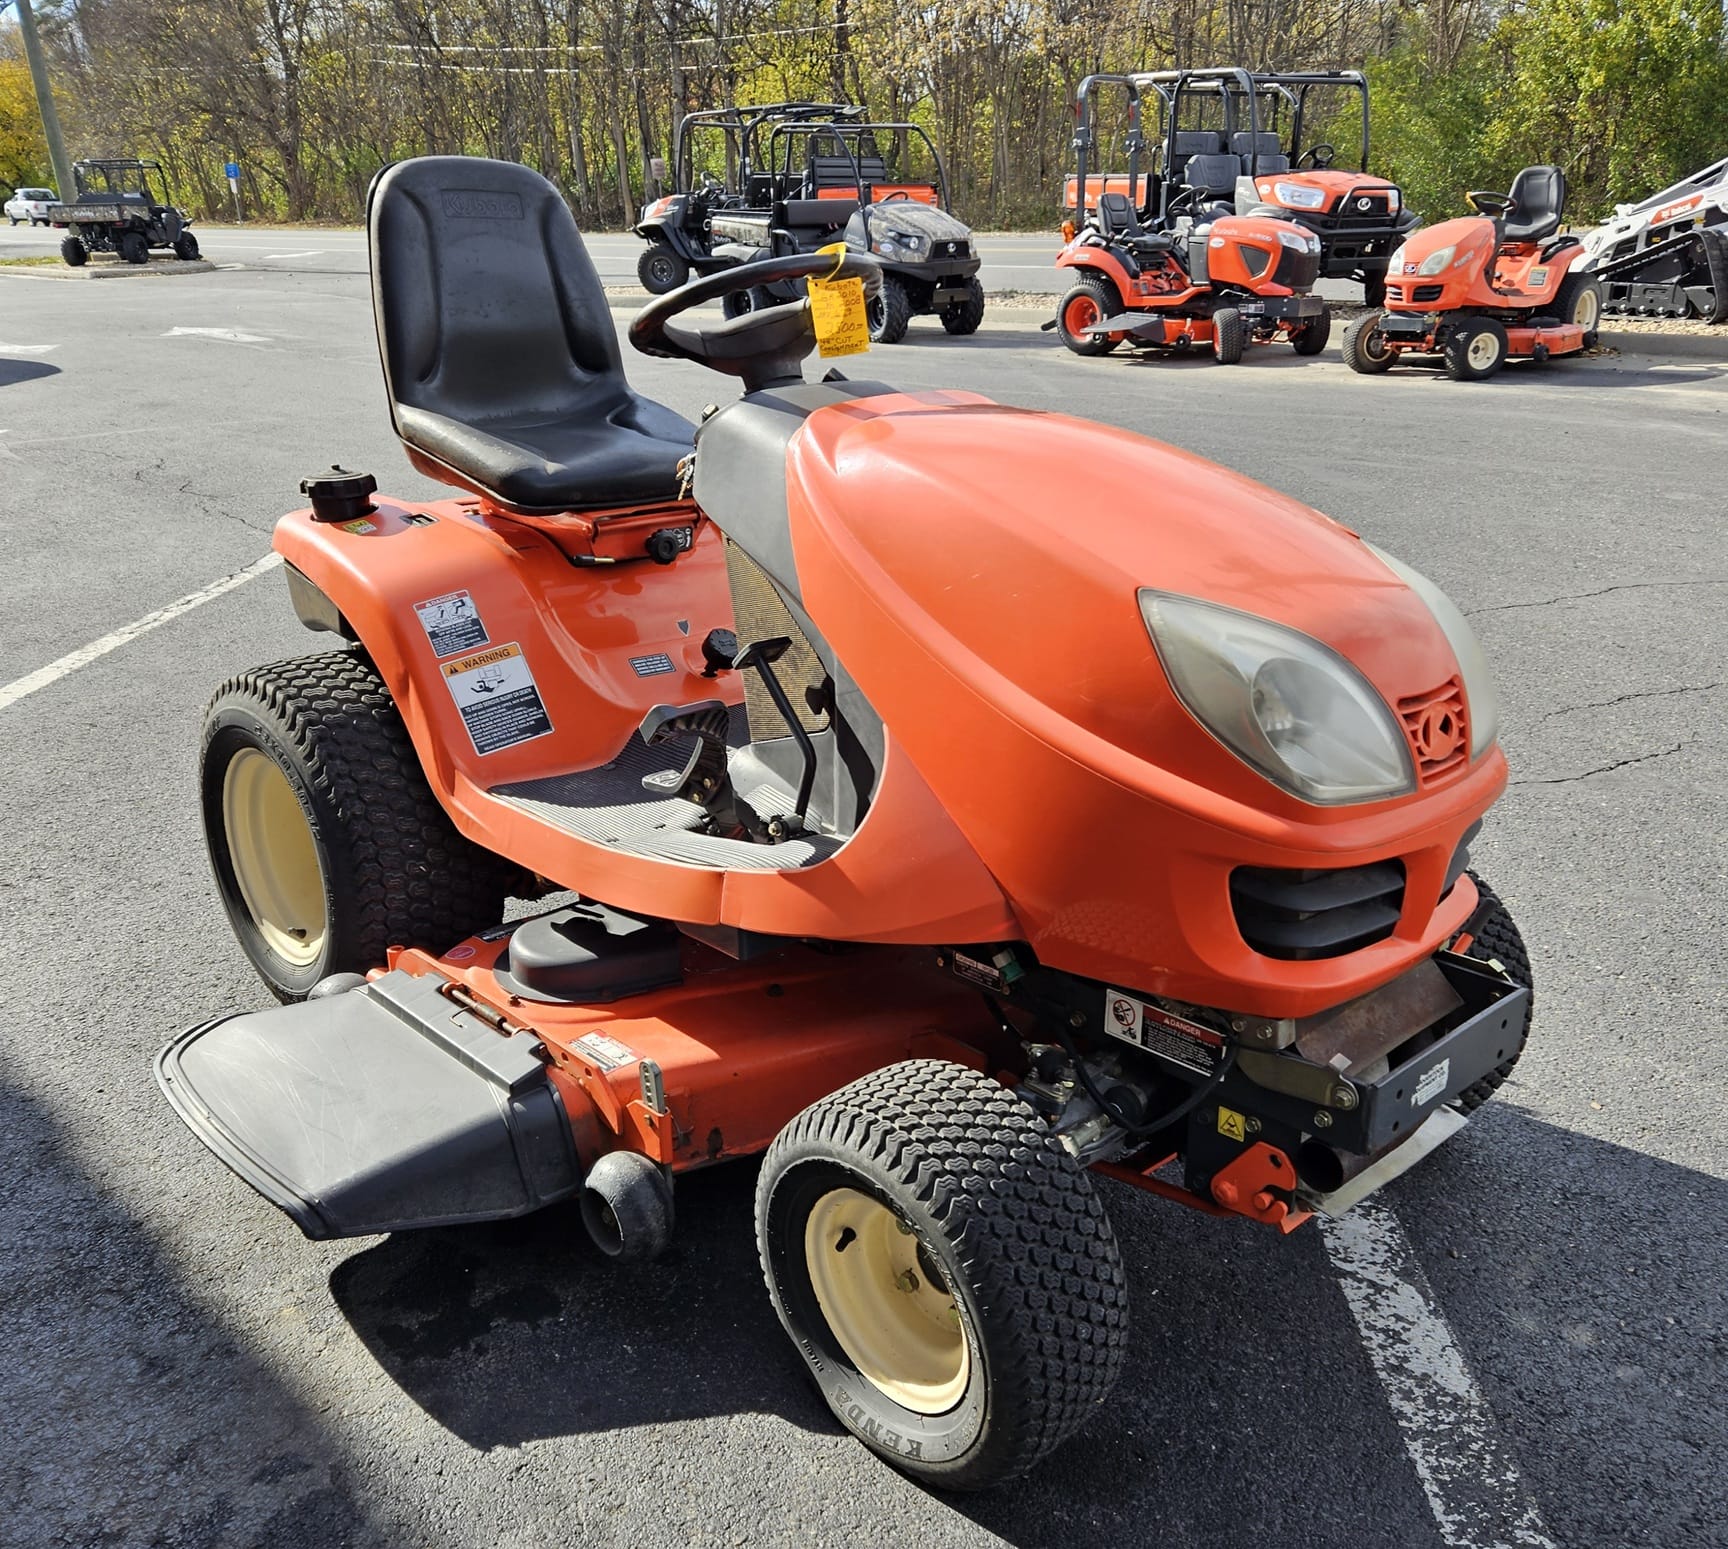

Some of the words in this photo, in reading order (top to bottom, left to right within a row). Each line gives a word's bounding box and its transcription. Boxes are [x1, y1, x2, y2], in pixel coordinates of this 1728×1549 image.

[446, 194, 520, 216] Kubota
[835, 336, 853, 344] CUT
[462, 649, 511, 669] WARNING
[1170, 1018, 1201, 1037] DANGER
[833, 1384, 923, 1460] KENDA
